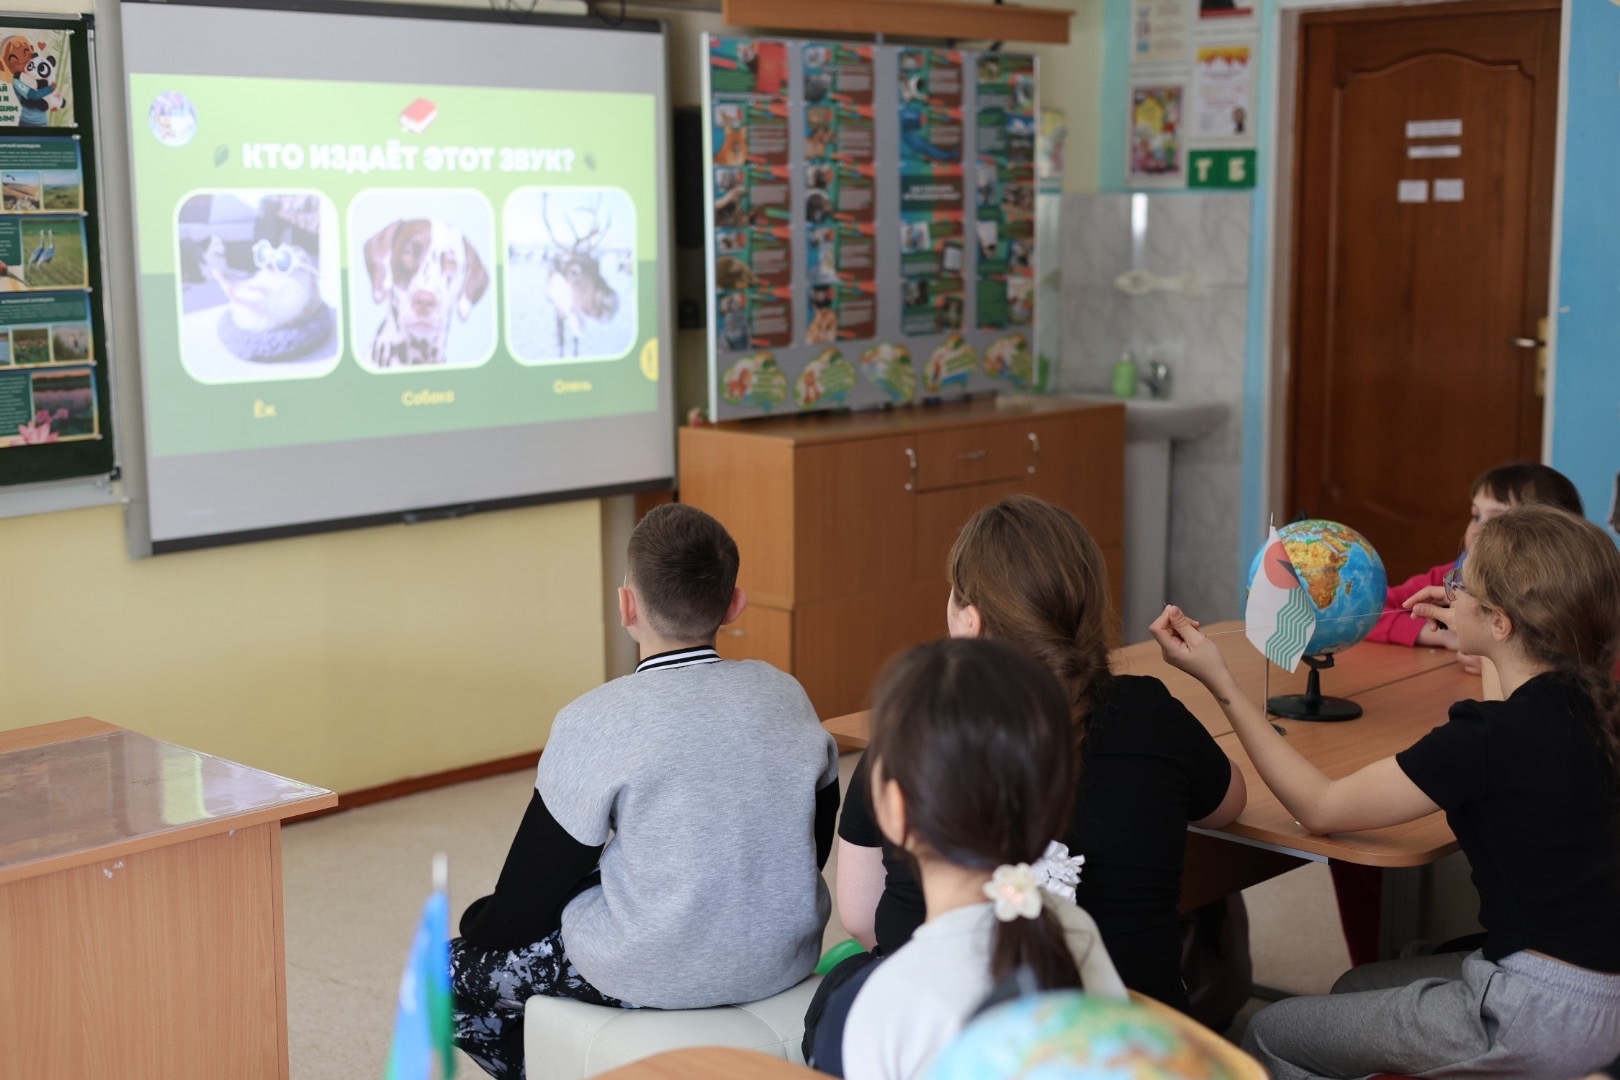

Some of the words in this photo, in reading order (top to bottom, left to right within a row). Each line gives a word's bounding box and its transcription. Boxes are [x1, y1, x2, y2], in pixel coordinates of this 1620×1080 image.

[242, 143, 305, 170] КТО
[309, 139, 419, 174] ИЗДАЁТ
[423, 145, 496, 172] ЭТОТ
[499, 147, 575, 173] ЗВУК?
[402, 388, 455, 407] Собака
[253, 398, 277, 419] Ёж
